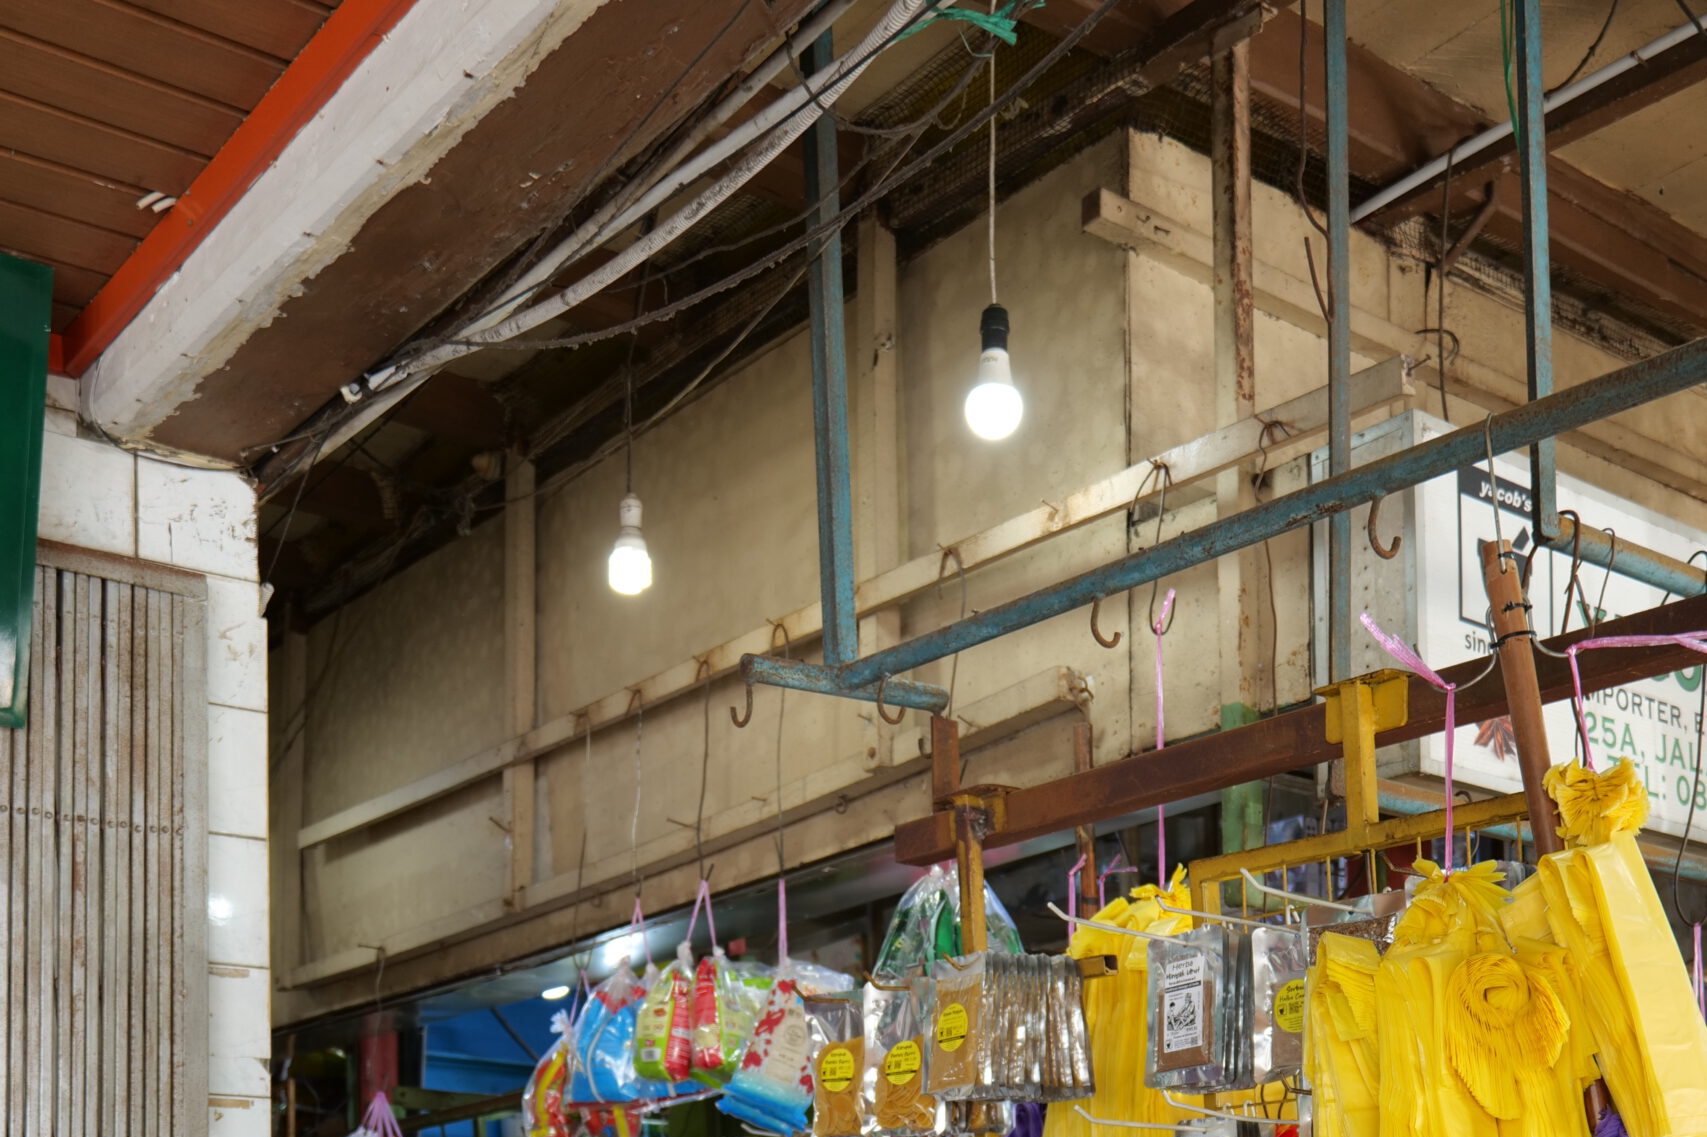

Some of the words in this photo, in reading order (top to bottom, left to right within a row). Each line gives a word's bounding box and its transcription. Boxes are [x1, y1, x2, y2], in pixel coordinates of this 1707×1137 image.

[1465, 631, 1491, 654] sin
[1583, 688, 1688, 731] MPORTER,
[1655, 733, 1706, 776] JAL
